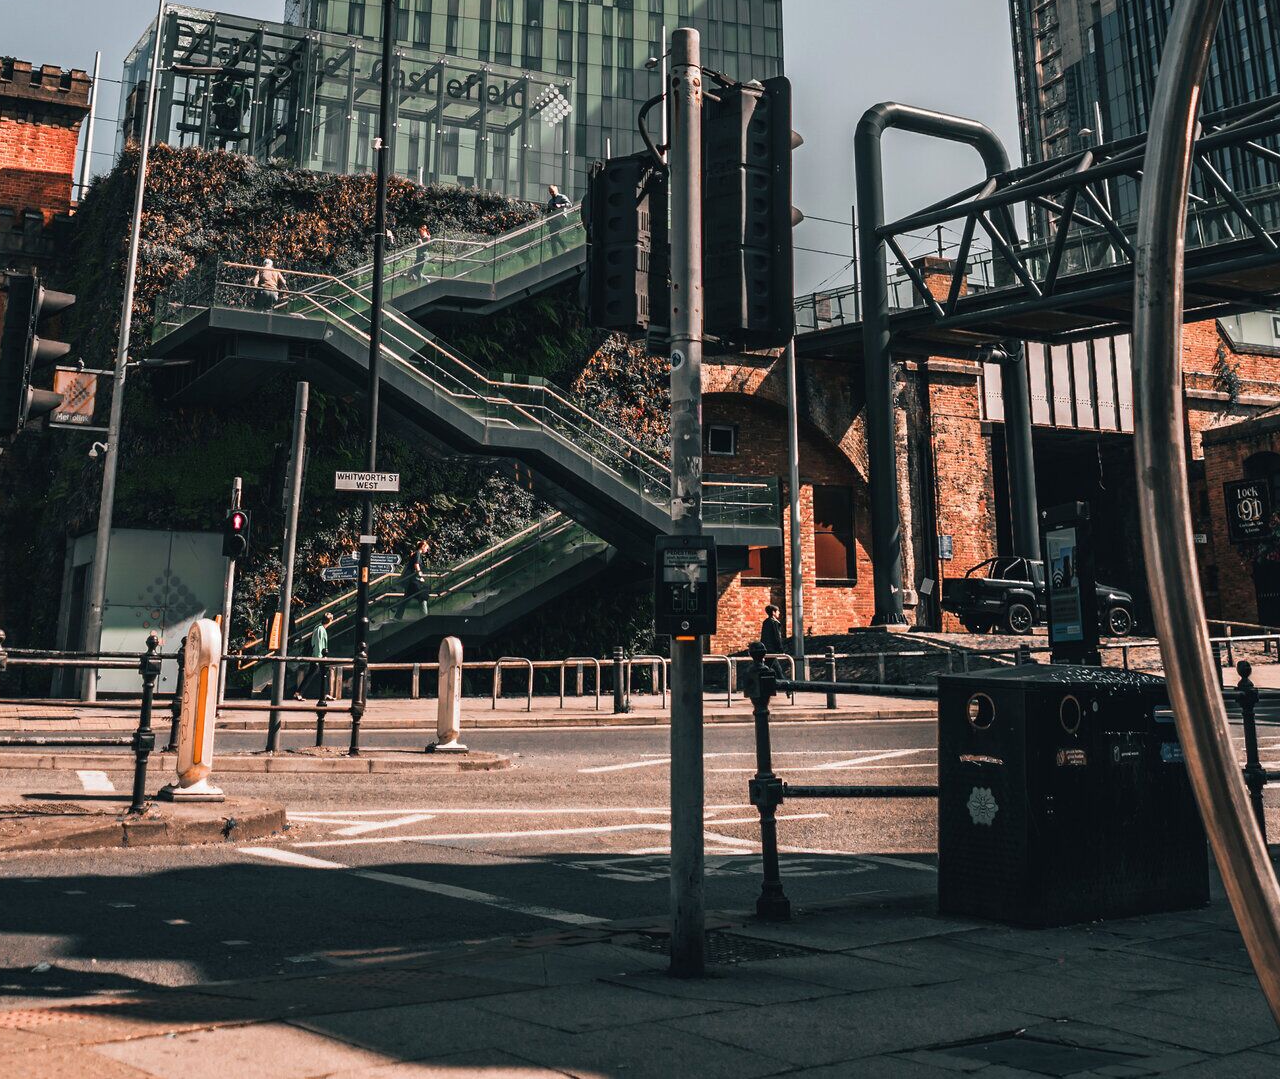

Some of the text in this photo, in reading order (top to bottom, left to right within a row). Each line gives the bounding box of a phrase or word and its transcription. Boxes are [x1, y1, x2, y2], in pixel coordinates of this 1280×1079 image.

[337, 473, 386, 482] WHITWORTH
[356, 482, 378, 490] WEST
[1241, 499, 1261, 521] 91
